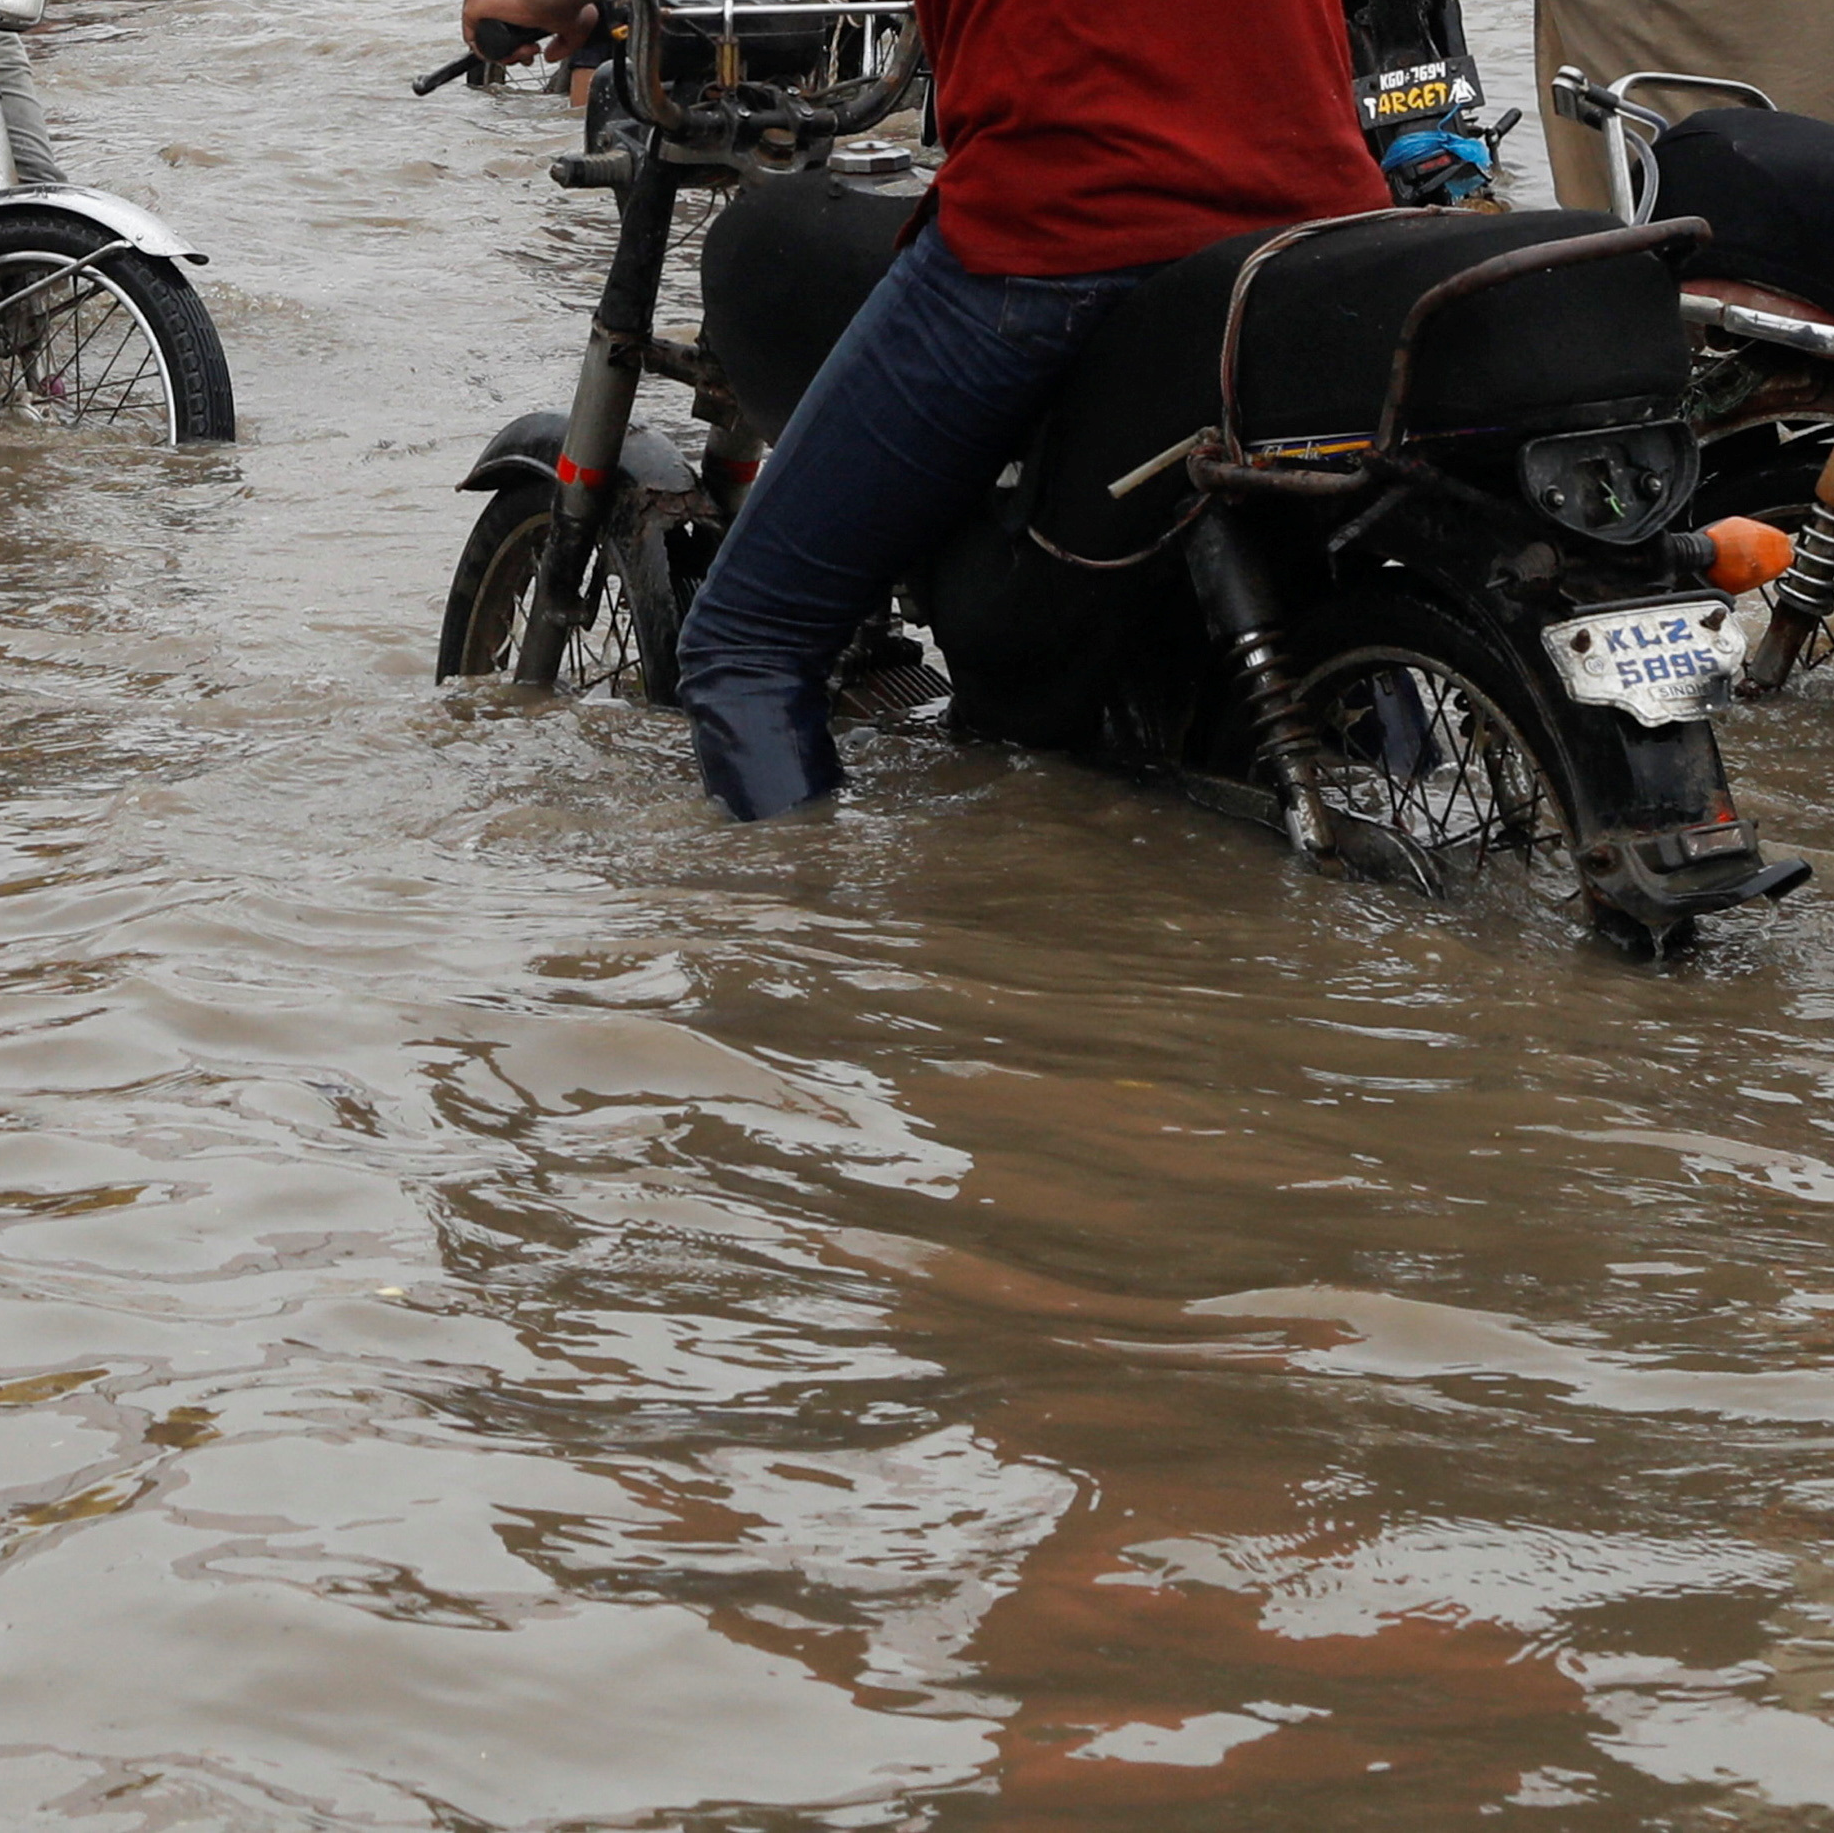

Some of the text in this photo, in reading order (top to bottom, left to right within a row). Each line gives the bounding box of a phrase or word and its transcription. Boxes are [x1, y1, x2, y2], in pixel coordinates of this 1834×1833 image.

[1363, 82, 1448, 119] TARGET
[1605, 618, 1693, 654] KLZ
[1616, 647, 1719, 689] 5895
